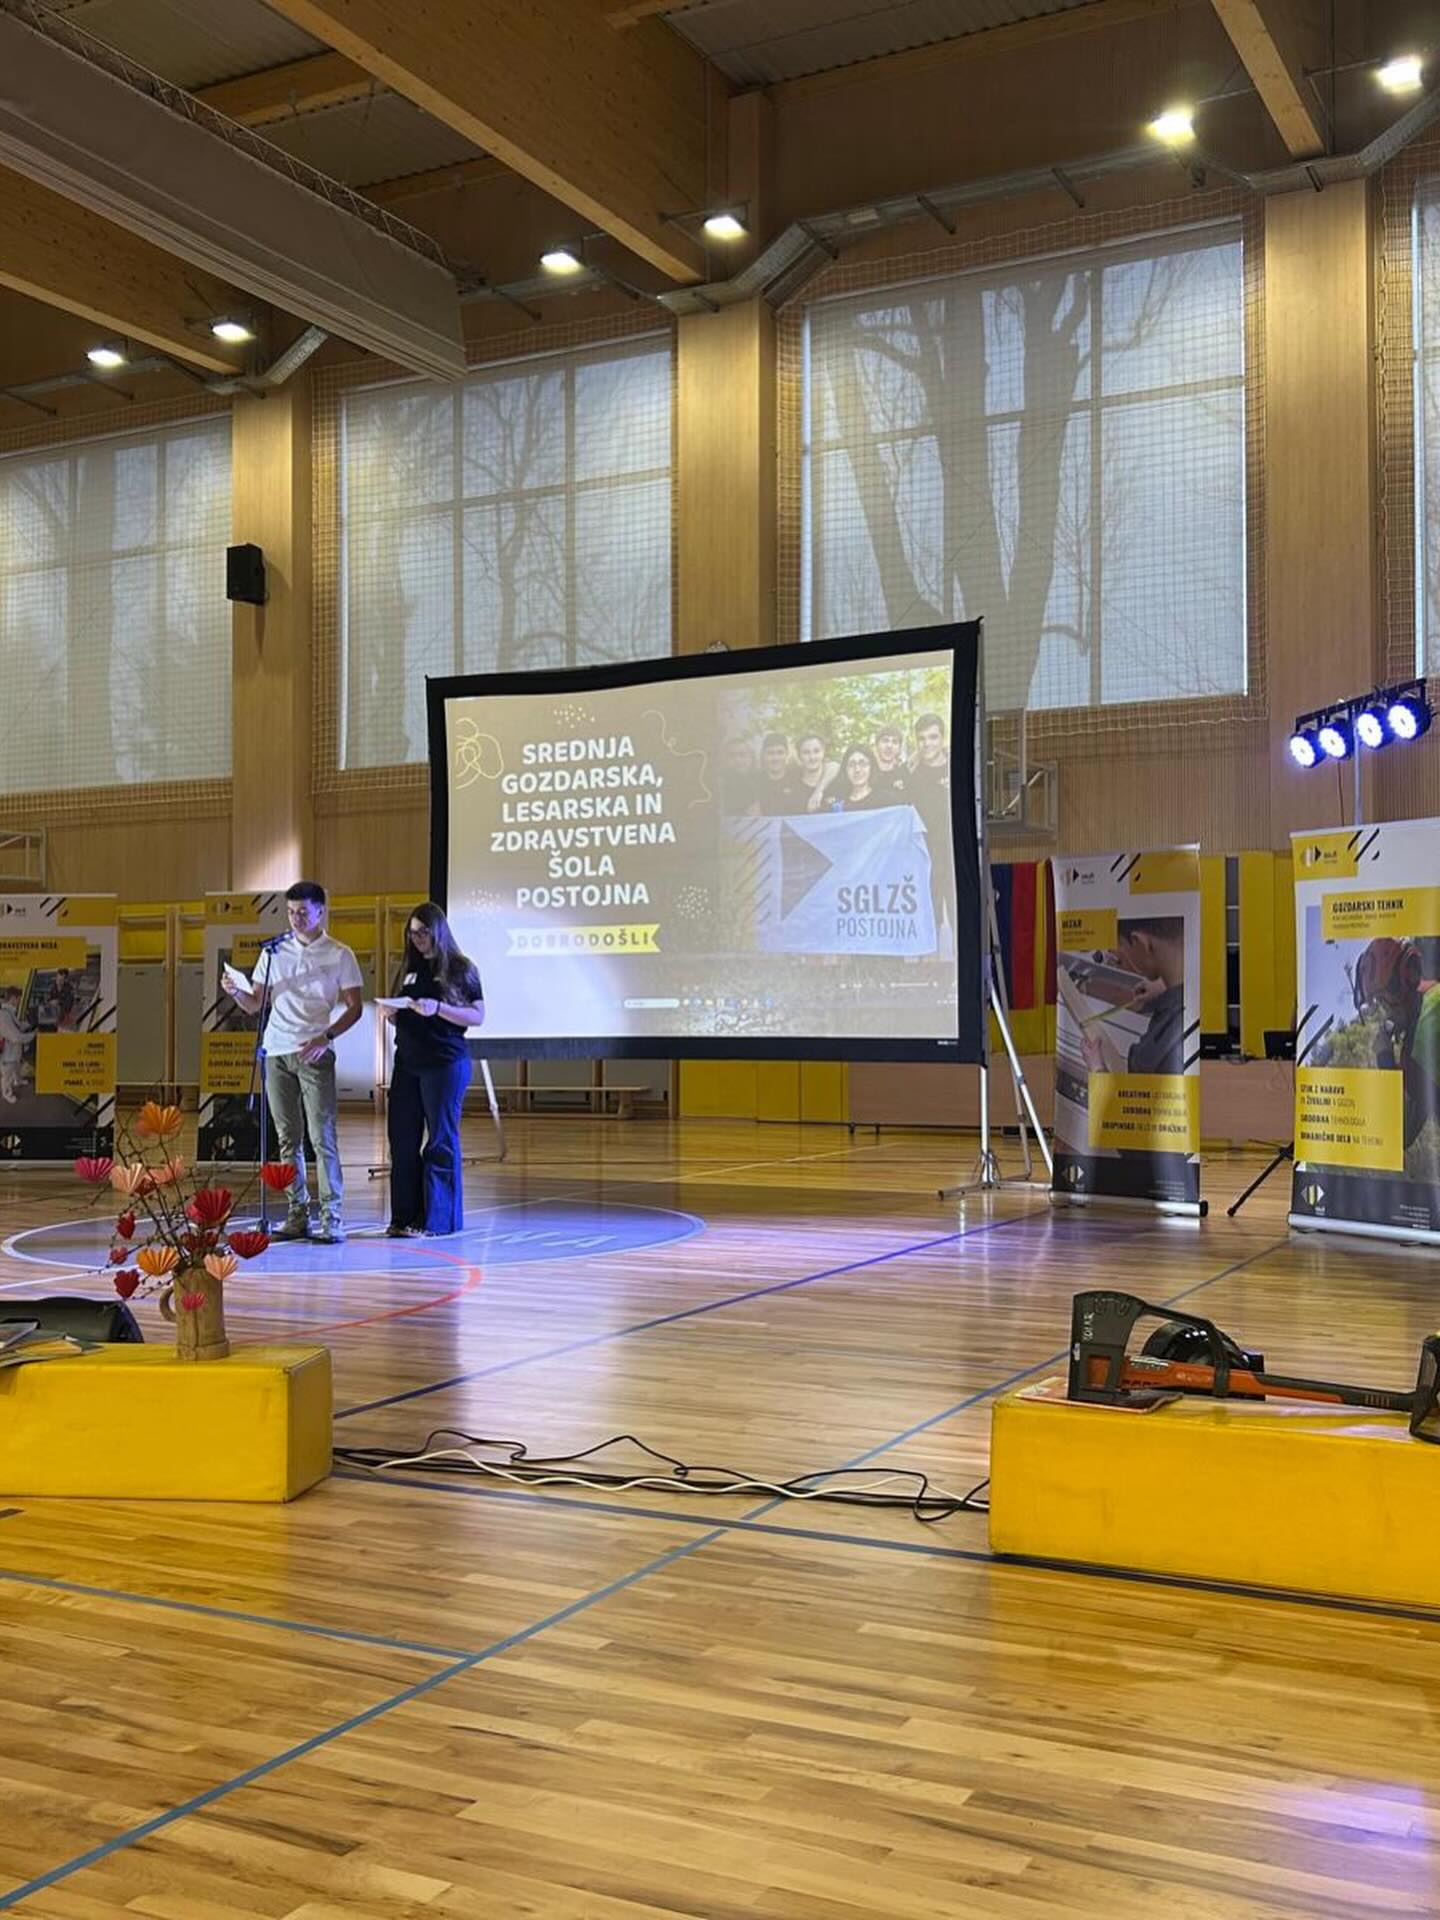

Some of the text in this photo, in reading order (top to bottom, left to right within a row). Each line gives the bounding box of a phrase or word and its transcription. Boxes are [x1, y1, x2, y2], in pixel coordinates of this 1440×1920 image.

[522, 736, 635, 765] SREDNJA
[501, 763, 663, 795] GOZDARSKA,
[502, 792, 662, 823] LESARSKA IN
[490, 822, 676, 851] ZDRAVSTVENA
[548, 850, 615, 879] ŠOLA
[516, 883, 650, 909] POSTOJNA
[837, 874, 917, 914] SGLZŠ
[1332, 898, 1404, 914] GOZDARSKI TEHNIK
[517, 928, 648, 949] DOBRODOŠLI
[837, 917, 917, 939] POSTOJNA
